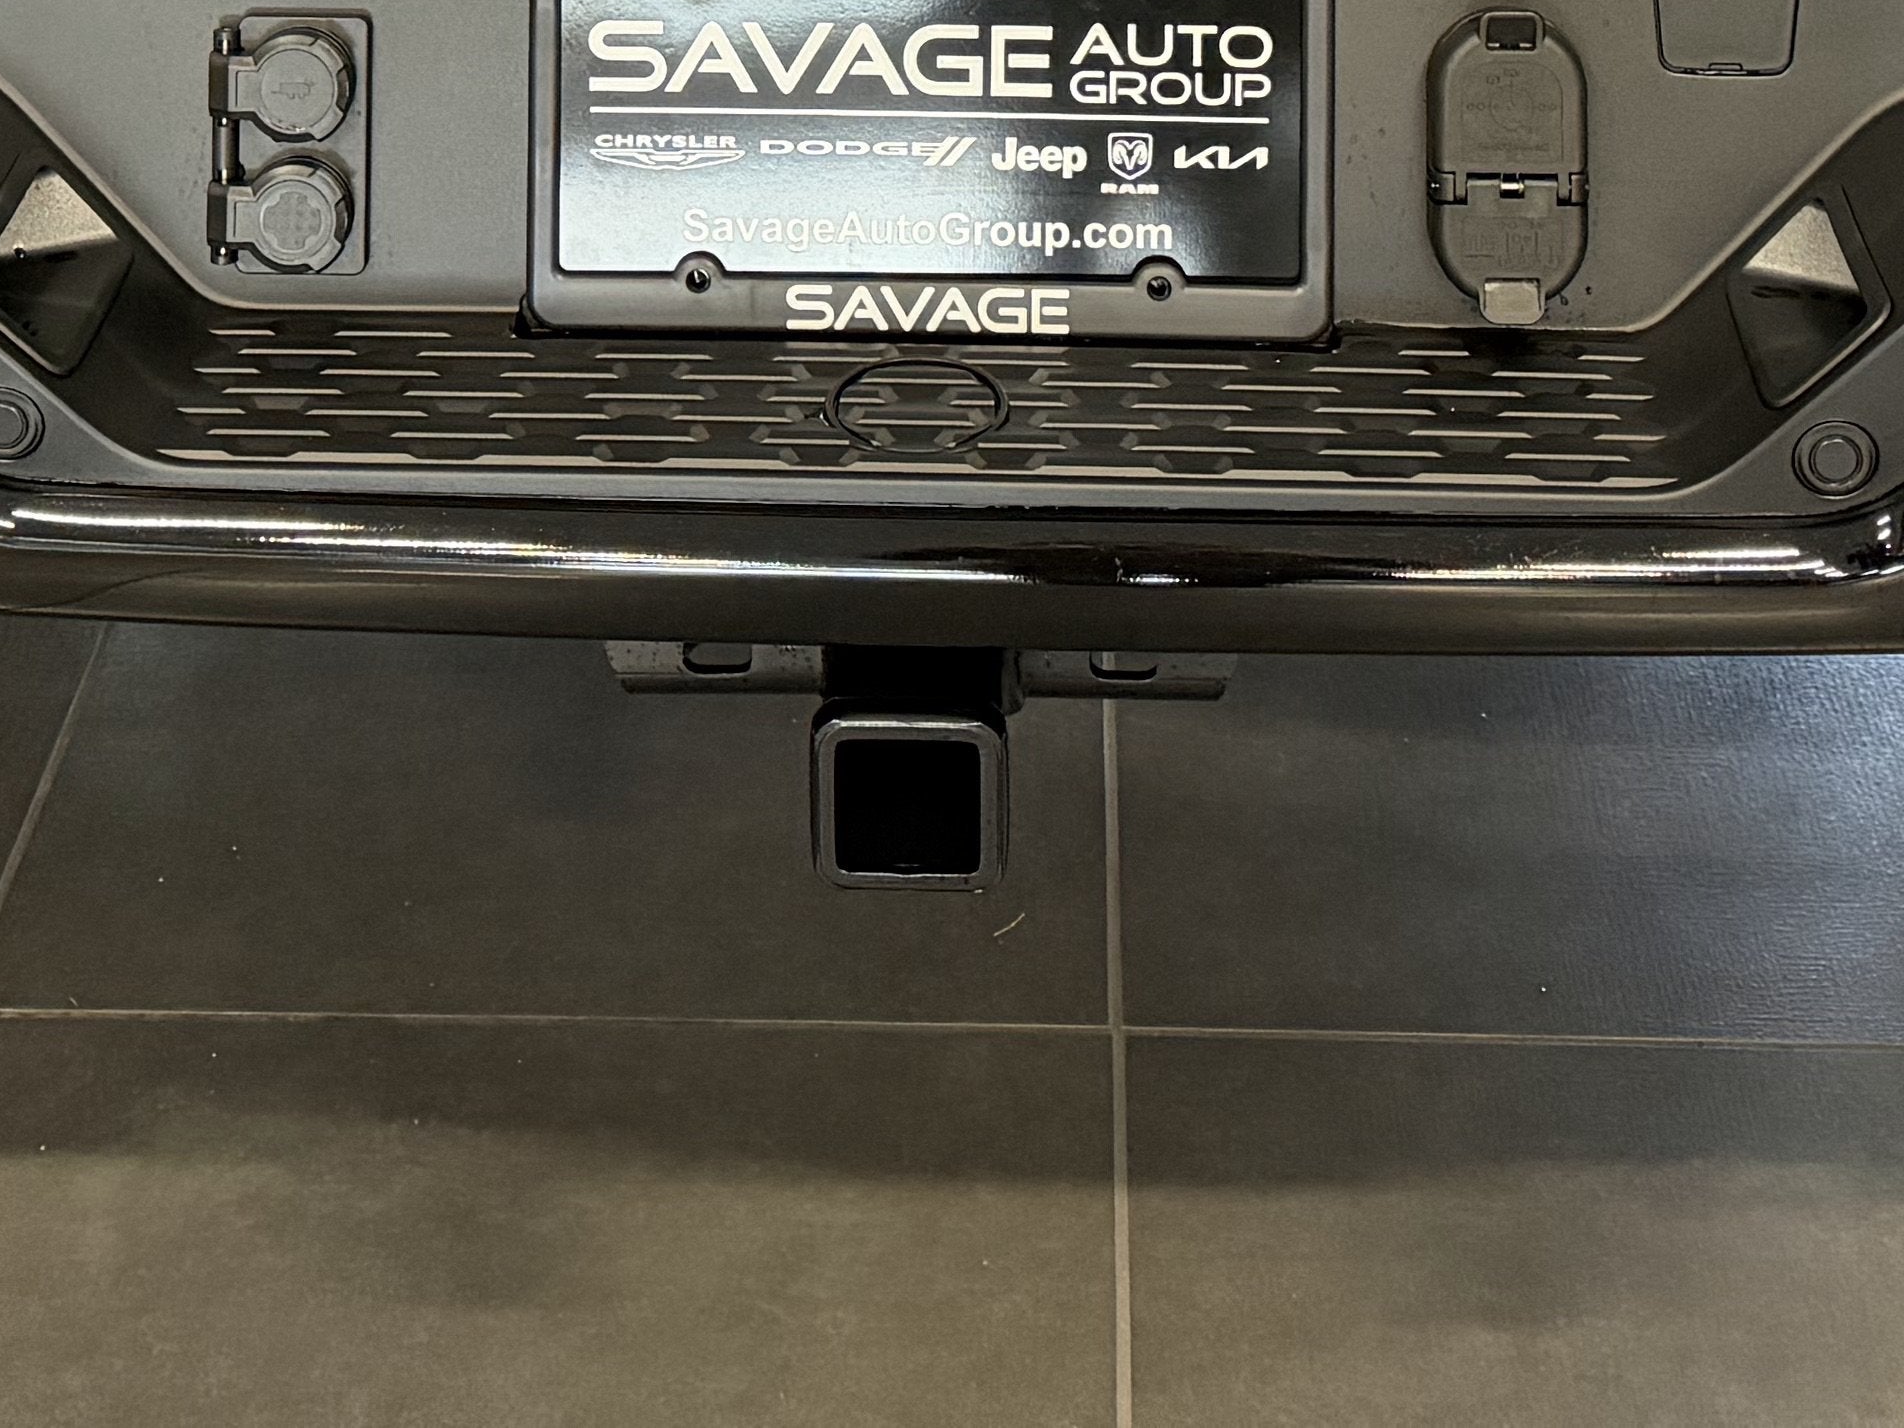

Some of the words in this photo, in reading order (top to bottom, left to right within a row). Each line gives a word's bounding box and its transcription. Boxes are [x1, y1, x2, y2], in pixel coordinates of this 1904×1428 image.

[587, 19, 1054, 98] SAVAGE
[1069, 22, 1274, 69] AUTO
[1068, 70, 1273, 108] GROUP
[594, 133, 737, 149] CHRYSLER
[759, 138, 951, 159] DODGE
[991, 136, 1088, 179] Jeep
[1100, 182, 1160, 195] RAM
[681, 207, 1173, 254] SavageAutoGroup.com
[784, 283, 1071, 335] SAVAGE
